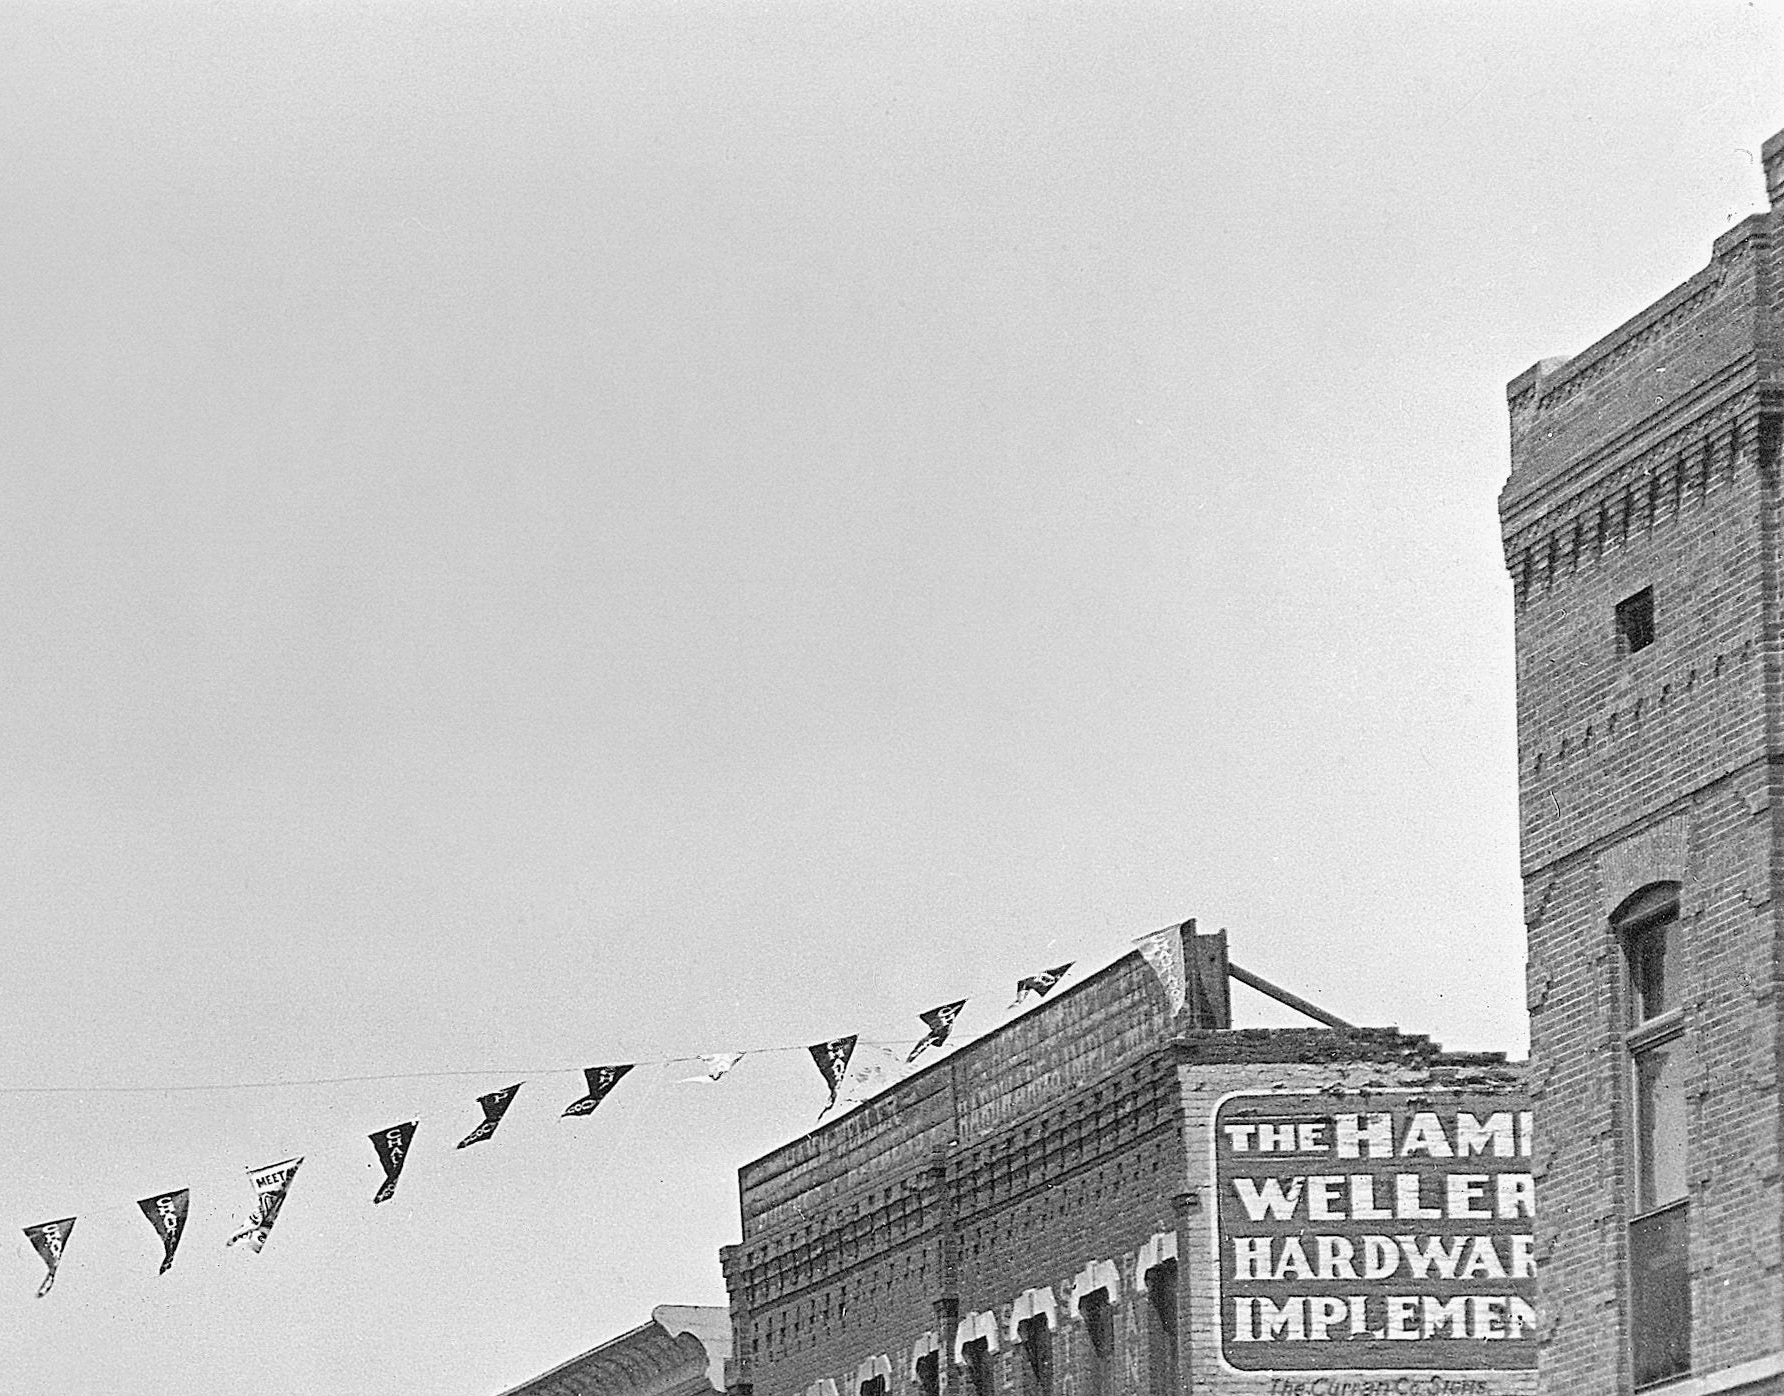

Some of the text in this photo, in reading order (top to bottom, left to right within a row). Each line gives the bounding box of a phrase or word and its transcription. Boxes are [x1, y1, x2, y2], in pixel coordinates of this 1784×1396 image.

[1224, 1111, 1533, 1159] THE HAM
[256, 1170, 287, 1188] MEET
[1233, 1173, 1536, 1221] WELLER
